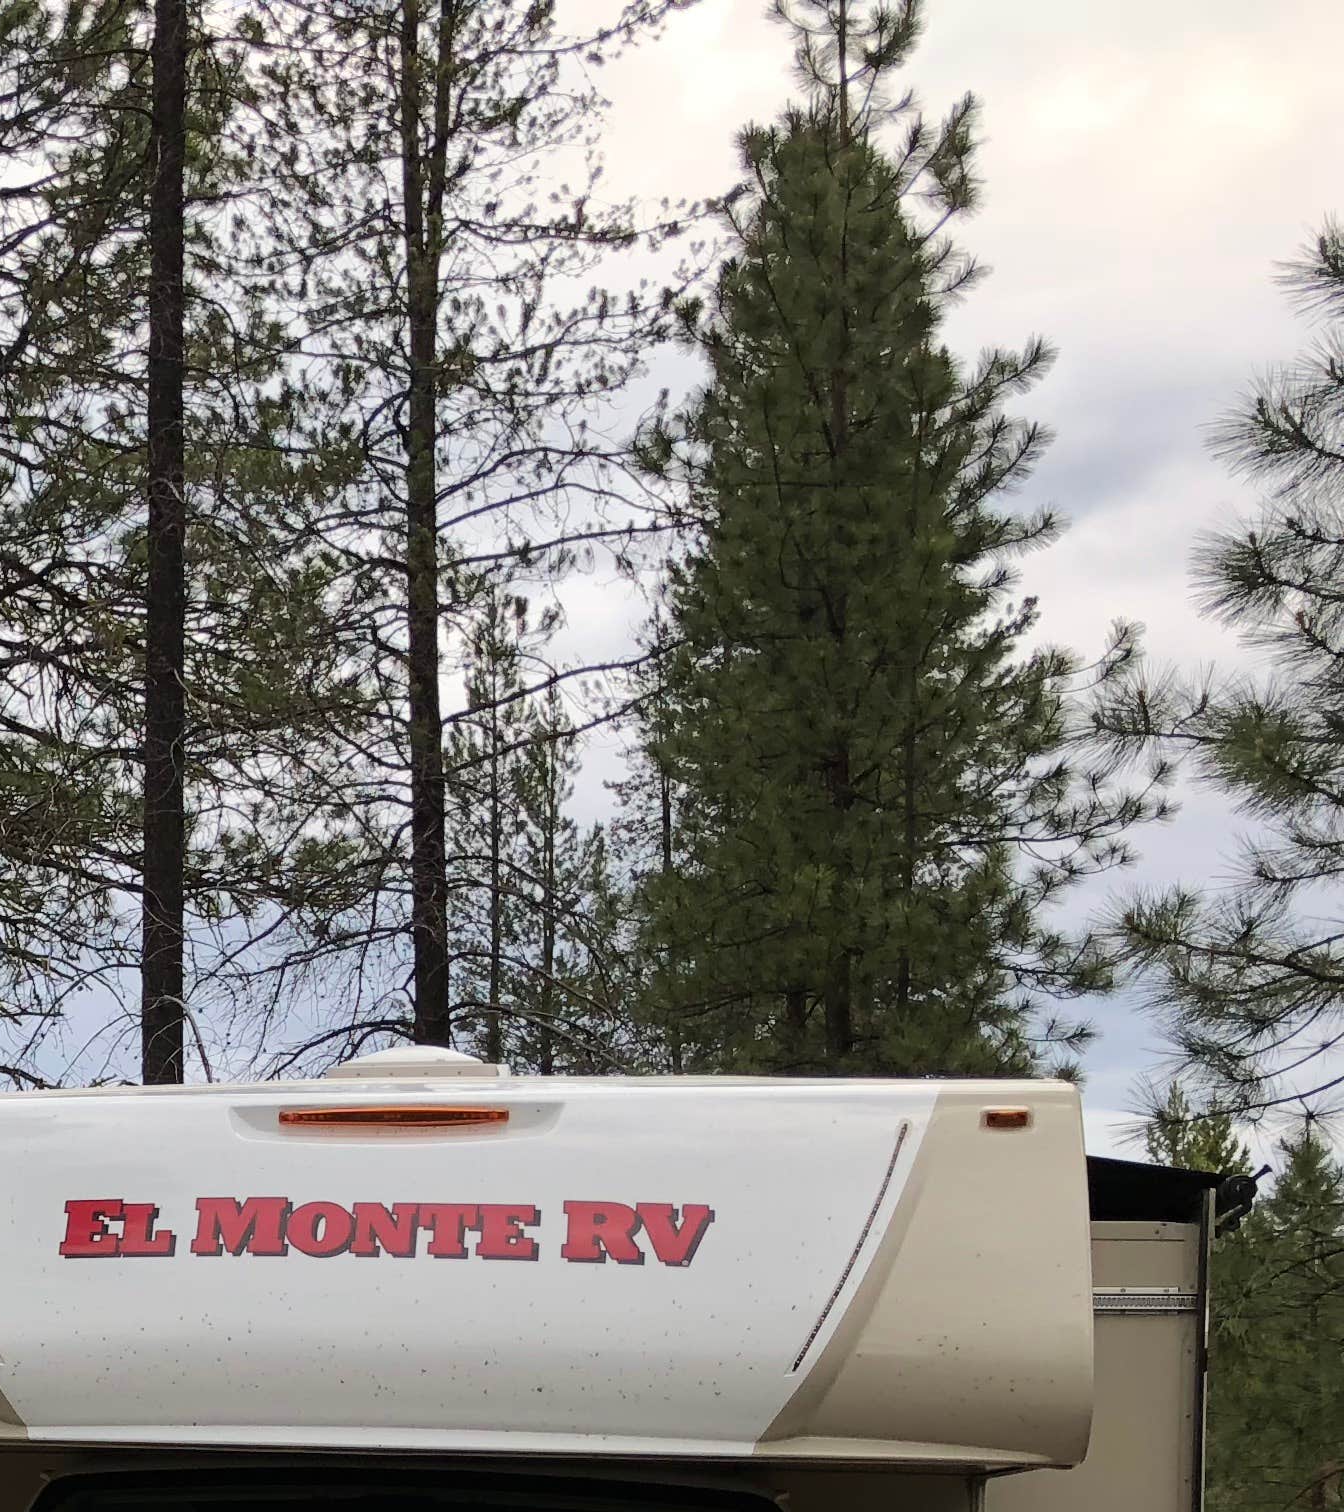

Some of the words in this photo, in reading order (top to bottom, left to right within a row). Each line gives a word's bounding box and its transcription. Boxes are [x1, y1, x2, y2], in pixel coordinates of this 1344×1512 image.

[59, 1198, 177, 1259] EL
[190, 1196, 543, 1262] MONTE
[559, 1199, 716, 1268] RV
